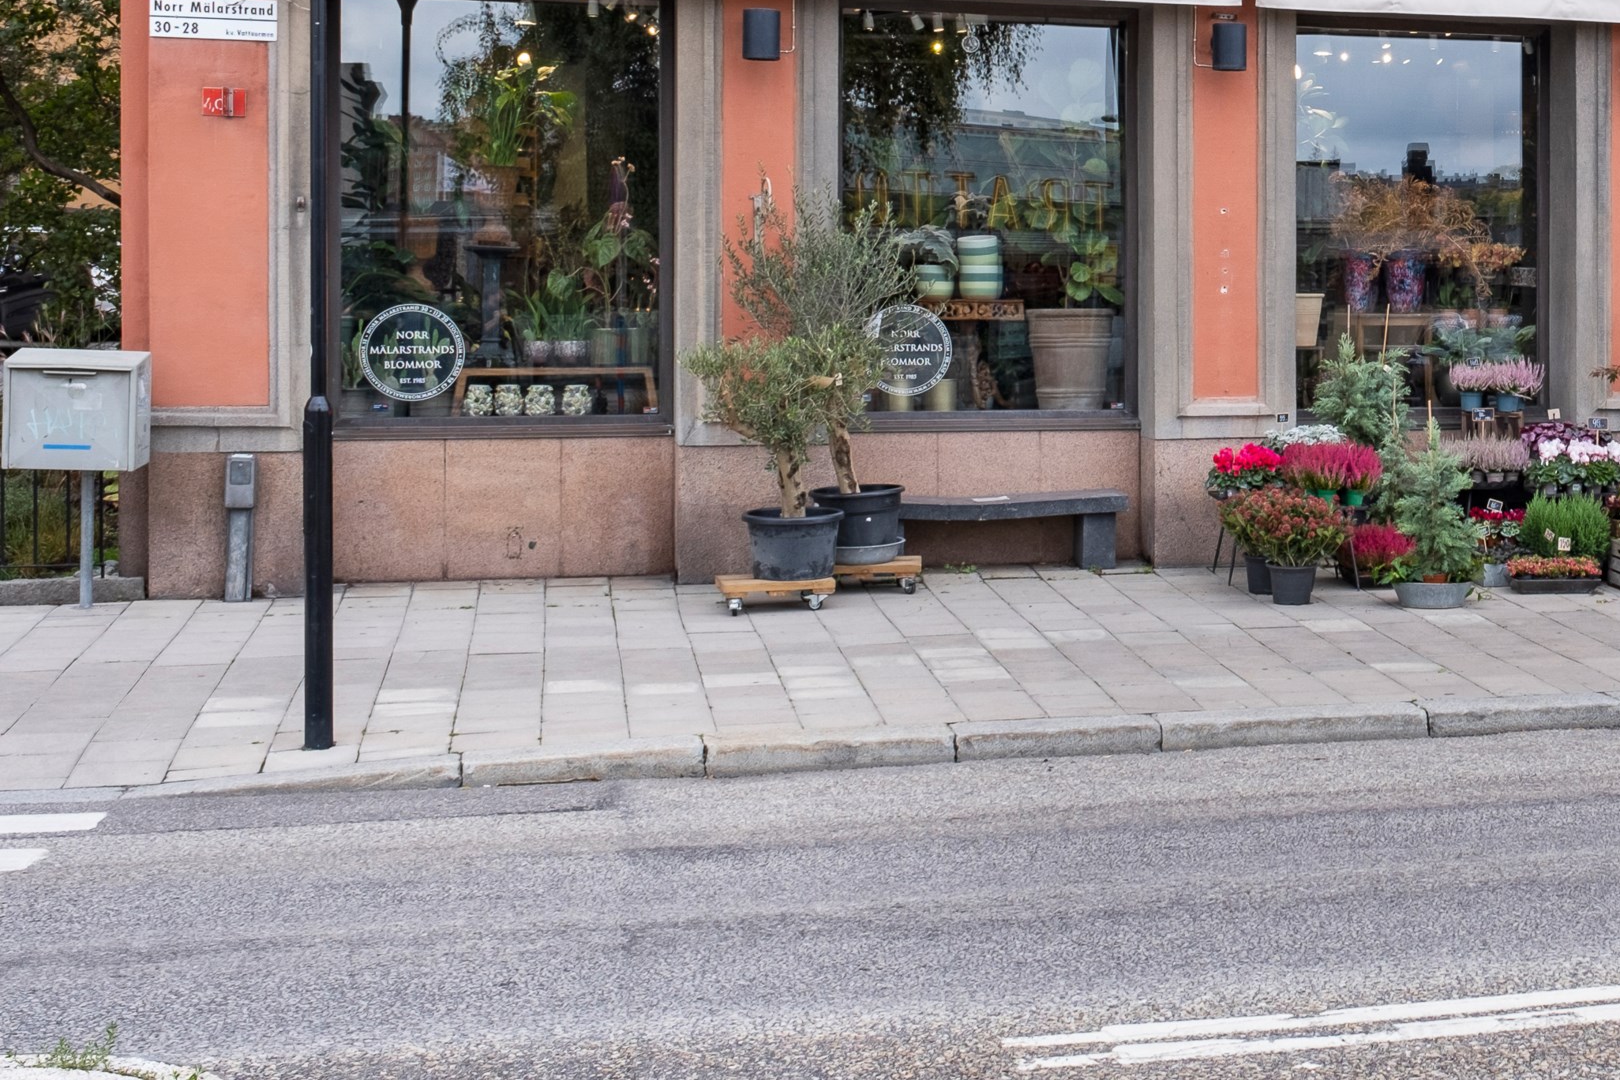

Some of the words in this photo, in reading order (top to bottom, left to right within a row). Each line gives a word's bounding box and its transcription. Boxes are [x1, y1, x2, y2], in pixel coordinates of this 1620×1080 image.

[154, 0, 183, 12] Norr
[190, 1, 274, 16] Mälarstrand
[396, 331, 430, 340] NORR
[369, 345, 455, 355] MÄLARSTRANDS
[884, 343, 943, 352] RSTRANDS
[384, 360, 442, 369] BLOMMOR
[880, 358, 931, 366] OMMOR
